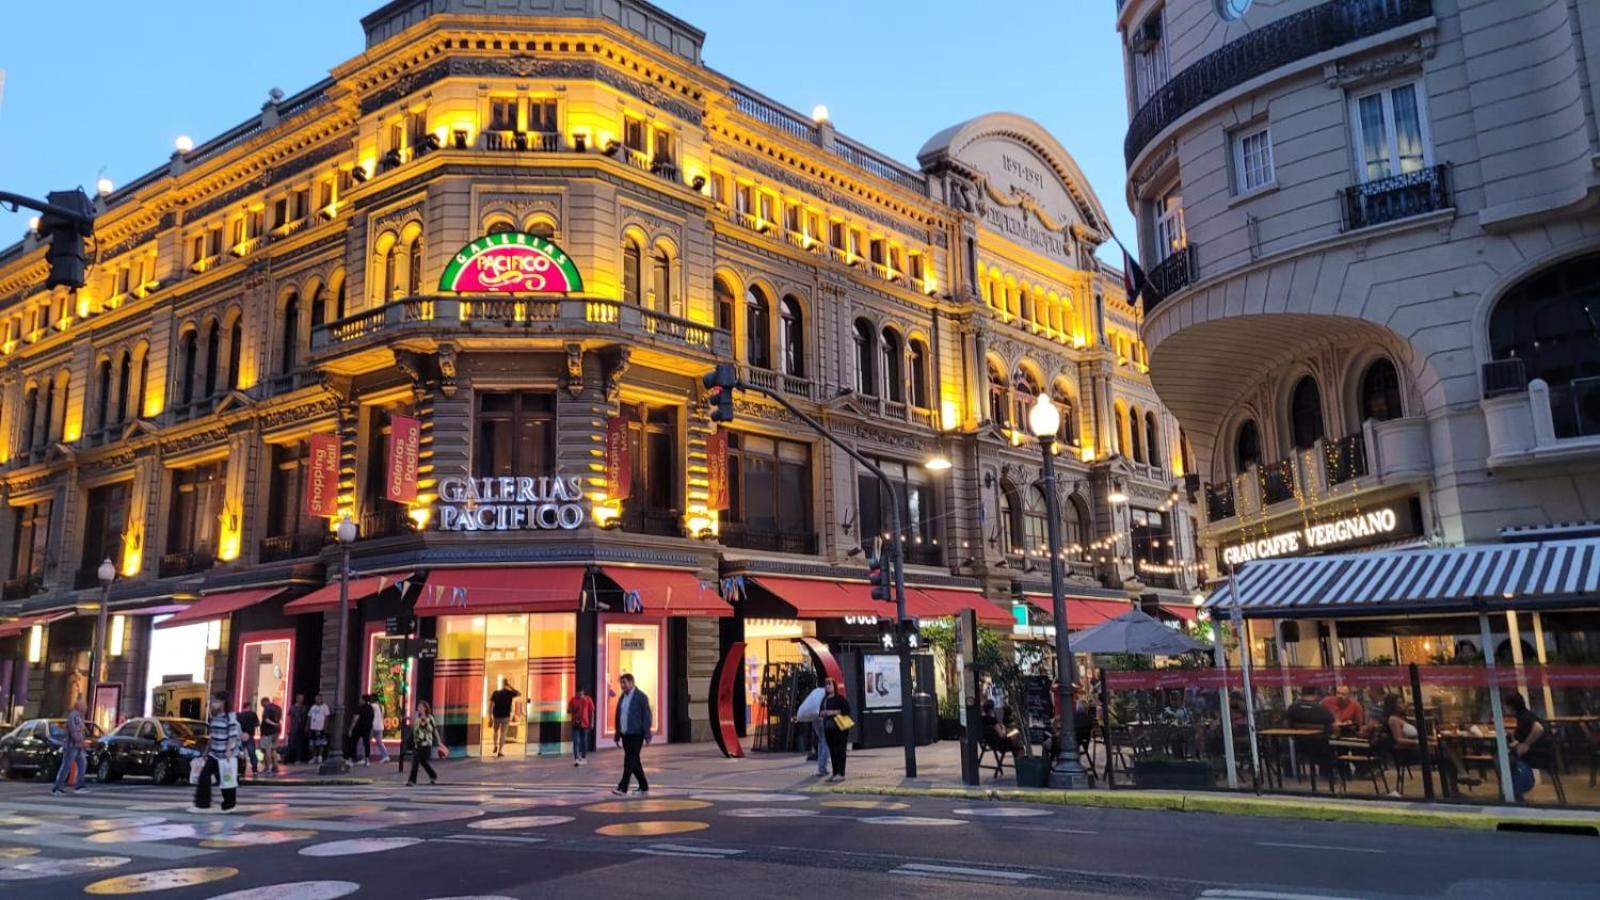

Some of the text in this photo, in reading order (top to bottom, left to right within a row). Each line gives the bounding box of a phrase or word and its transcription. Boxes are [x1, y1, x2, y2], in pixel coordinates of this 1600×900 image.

[456, 233, 568, 264] GALERIAS
[476, 255, 551, 272] PACIFICO
[326, 444, 336, 472] Mall
[312, 449, 326, 512] Shopping
[438, 476, 583, 502] GALERIAS
[439, 504, 583, 530] PACIFICO
[1223, 541, 1256, 565] GRAN
[1305, 508, 1397, 547] VERGNANO
